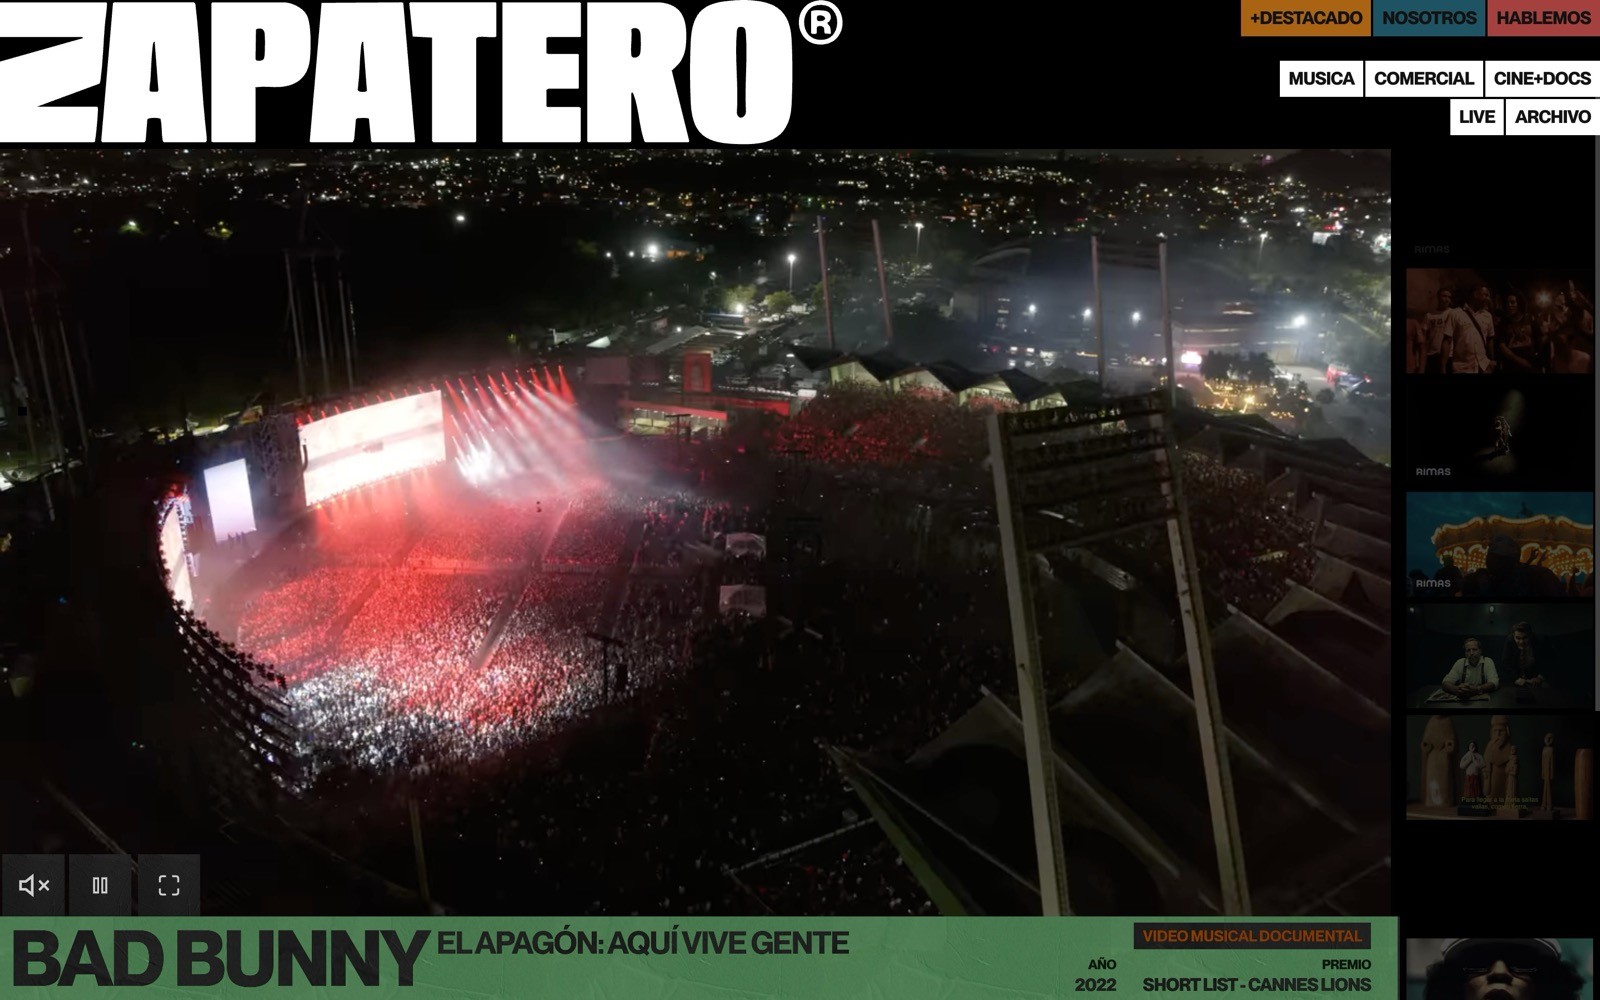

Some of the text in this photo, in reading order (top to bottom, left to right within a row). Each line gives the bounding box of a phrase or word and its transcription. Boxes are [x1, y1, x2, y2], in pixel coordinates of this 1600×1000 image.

[1250, 11, 1363, 25] +DESTACADO
[1382, 11, 1477, 25] NOSOTROS
[1497, 11, 1592, 25] HABLEMOS
[1289, 71, 1355, 86] MUSICA
[1374, 71, 1475, 86] COMERCIAL
[1494, 71, 1592, 86] CINE+DOCS
[1459, 109, 1496, 124] LIVE
[1515, 109, 1592, 124] ARCHIVO
[1416, 467, 1451, 476] RIMAS
[1416, 579, 1451, 588] RIMAS
[437, 924, 849, 956] EL APAGÓN: AQUÍ VIVE GENTE
[1142, 929, 1363, 942] VIDEO MUSICAL DOCUMENTAL
[13, 930, 432, 987] BAD BUNNY
[1088, 957, 1117, 970] AÑO
[1322, 959, 1372, 970] PREMIO
[1075, 978, 1117, 992] 2022
[1143, 977, 1202, 992] SHORT
[1203, 978, 1238, 992] LIST
[1248, 977, 1319, 992] CANNES
[1321, 977, 1371, 992] LIONS
